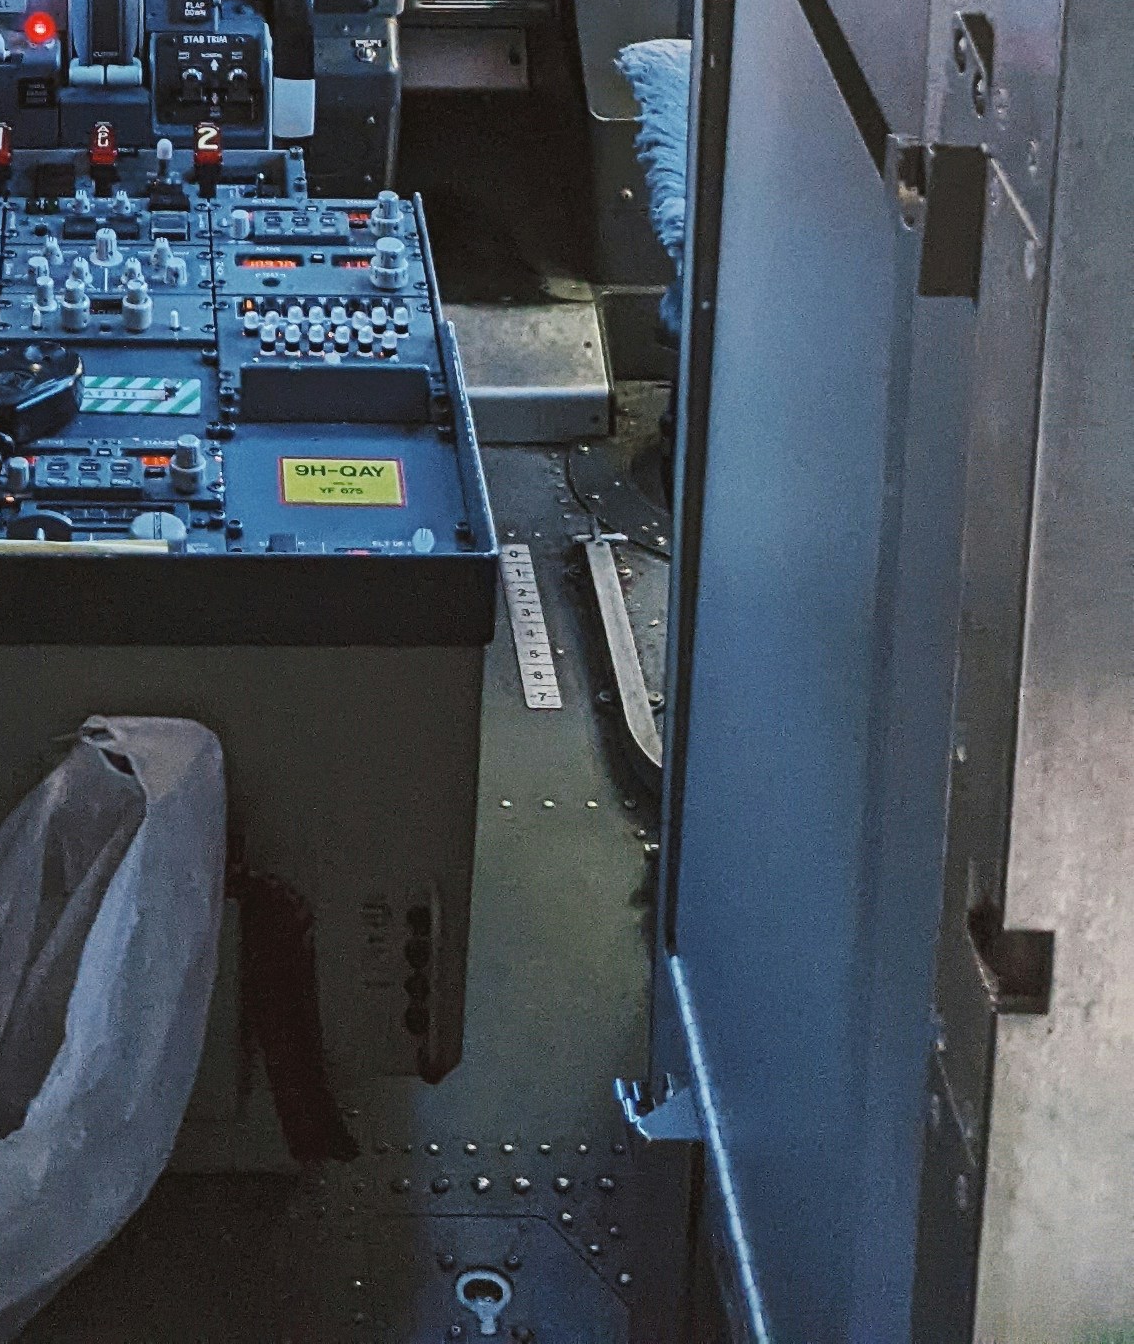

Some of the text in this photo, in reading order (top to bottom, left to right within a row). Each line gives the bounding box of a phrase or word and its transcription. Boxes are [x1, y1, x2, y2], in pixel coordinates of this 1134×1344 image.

[183, 35, 228, 44] STAB TRIM
[197, 126, 218, 150] 2
[294, 464, 384, 478] 9H-QAY
[340, 487, 364, 495] 675
[516, 569, 522, 577] 1
[518, 588, 526, 597] 2
[522, 608, 531, 616] 3
[538, 692, 547, 701] 7
